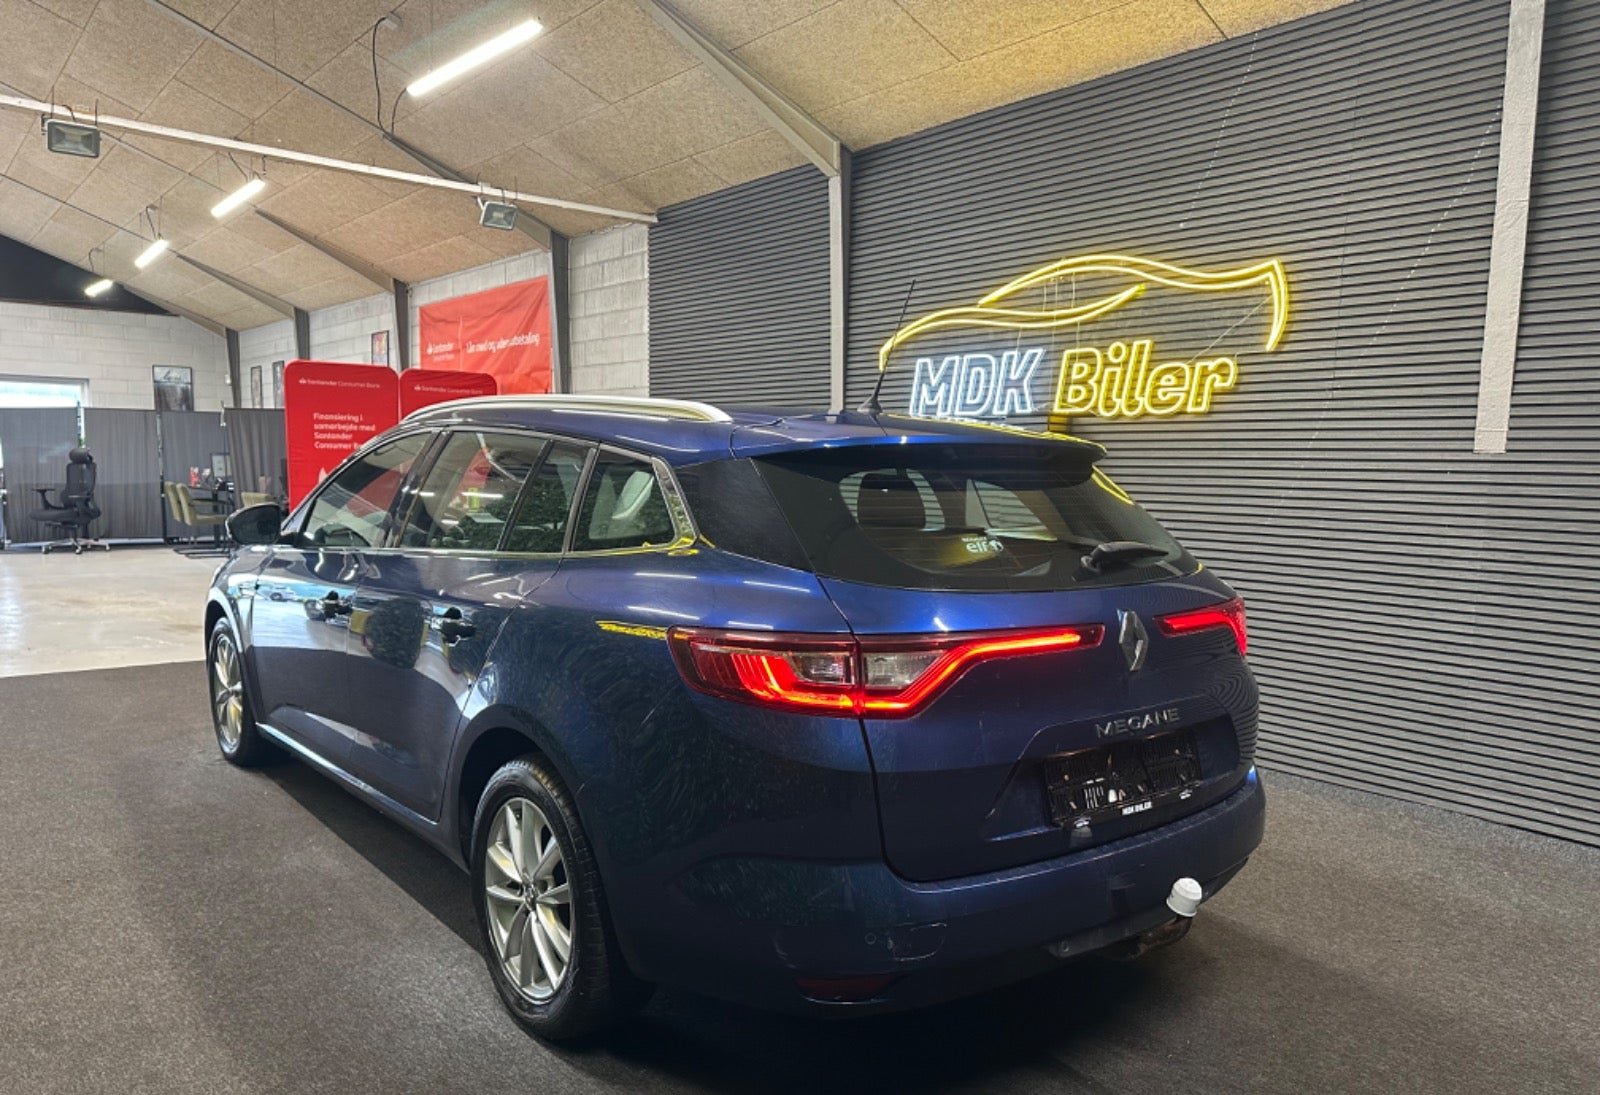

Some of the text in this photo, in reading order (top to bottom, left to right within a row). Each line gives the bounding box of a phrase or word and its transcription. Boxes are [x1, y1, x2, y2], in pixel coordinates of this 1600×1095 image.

[307, 378, 337, 386] Santander
[908, 339, 1239, 418] MDK Biler
[313, 412, 359, 422] Finansiering
[313, 423, 357, 432] samarbejde
[313, 432, 352, 440] Santander
[314, 441, 352, 449] Consumer
[966, 541, 988, 553] elf
[1095, 708, 1180, 738] MEGANE
